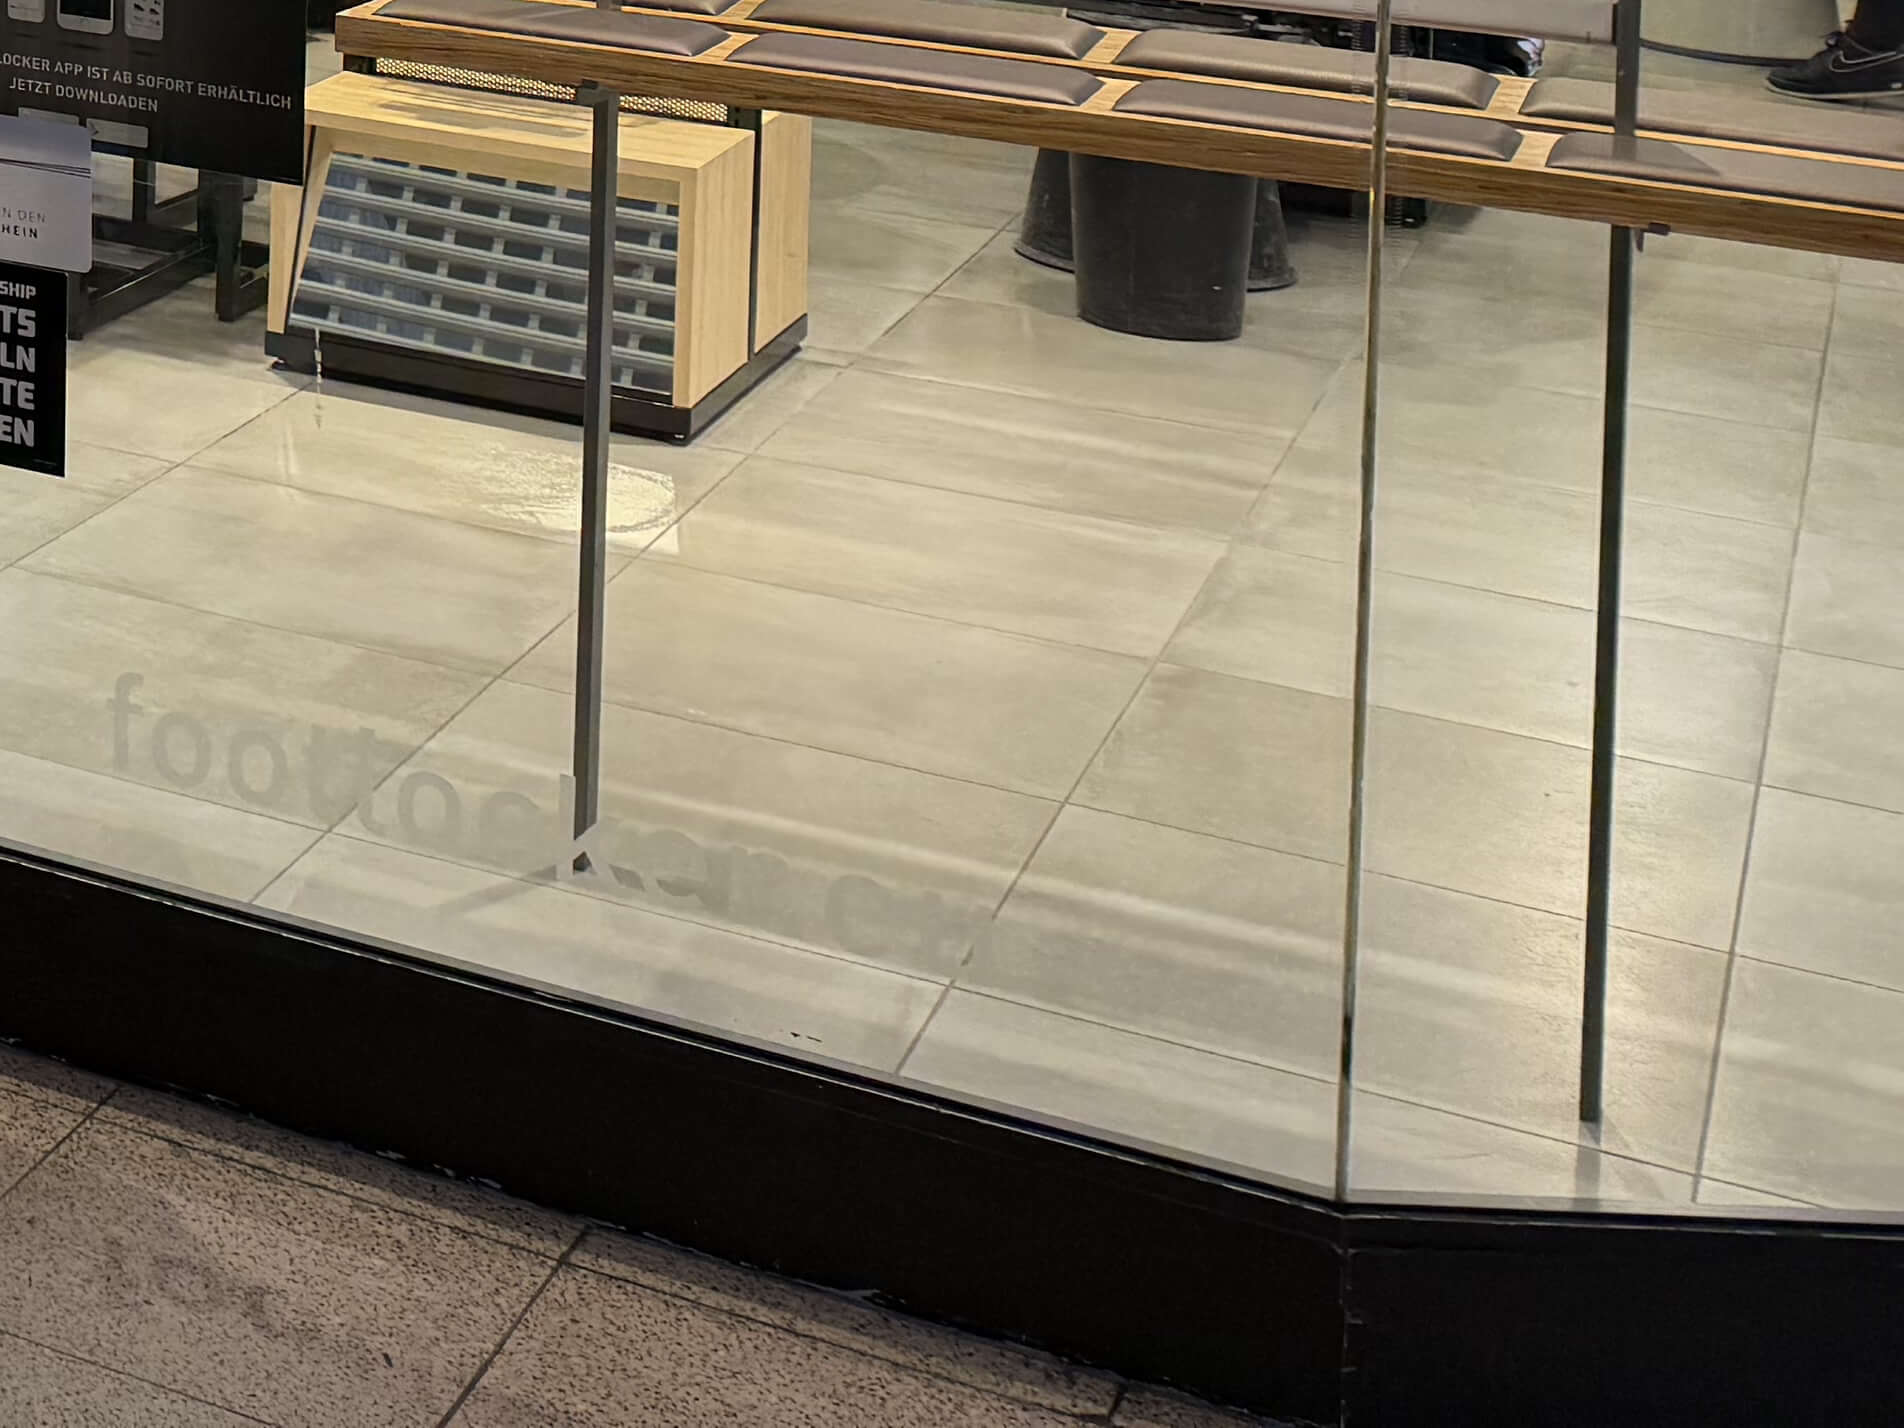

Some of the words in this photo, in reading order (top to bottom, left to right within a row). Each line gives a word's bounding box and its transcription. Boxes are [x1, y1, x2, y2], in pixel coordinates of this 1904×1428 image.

[9, 77, 52, 95] JETZT
[55, 85, 158, 113] DOWNLOADEN
[54, 61, 83, 76] APP
[87, 65, 110, 81] IST
[113, 70, 133, 84] AB
[136, 74, 194, 94] SOFORT
[197, 82, 292, 110] ERHÄLTLICH
[18, 209, 47, 224] DEN
